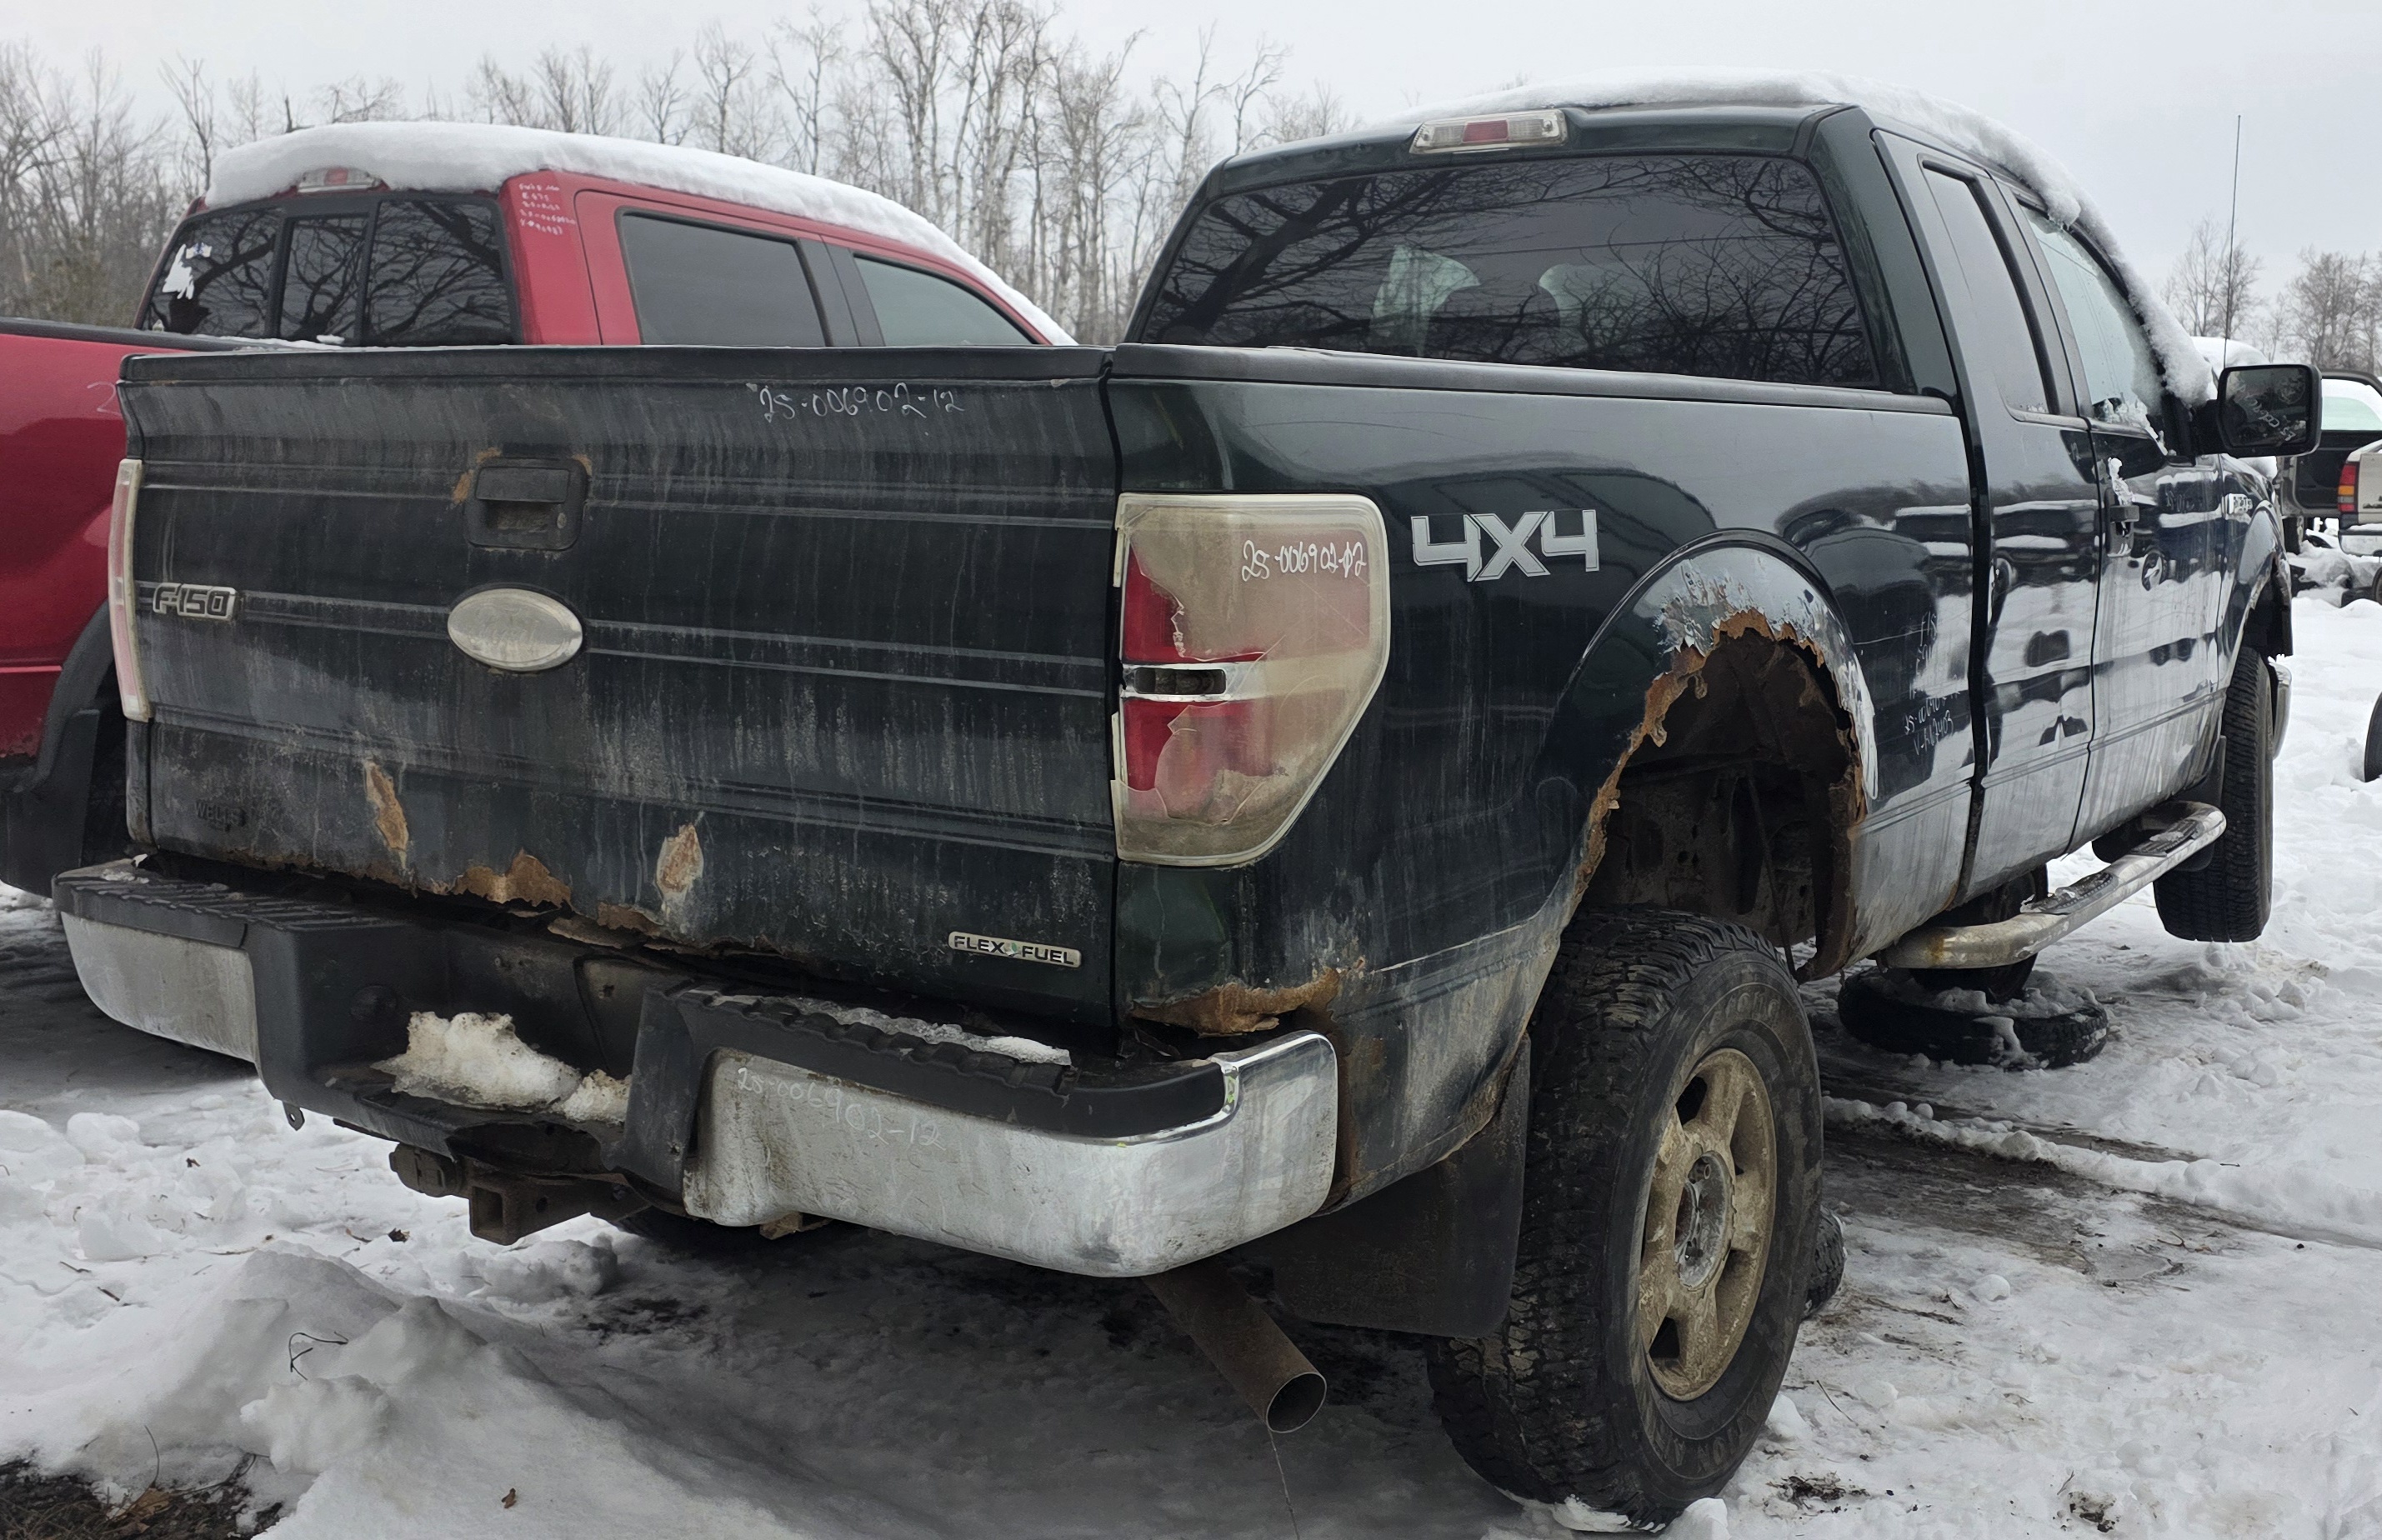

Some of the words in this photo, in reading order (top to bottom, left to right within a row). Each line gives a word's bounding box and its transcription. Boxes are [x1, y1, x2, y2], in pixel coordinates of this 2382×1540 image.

[1410, 509, 1599, 582] 4X4
[153, 582, 236, 619] F-150
[953, 935, 1005, 954] FLEX
[1022, 945, 1074, 965] FUEL
